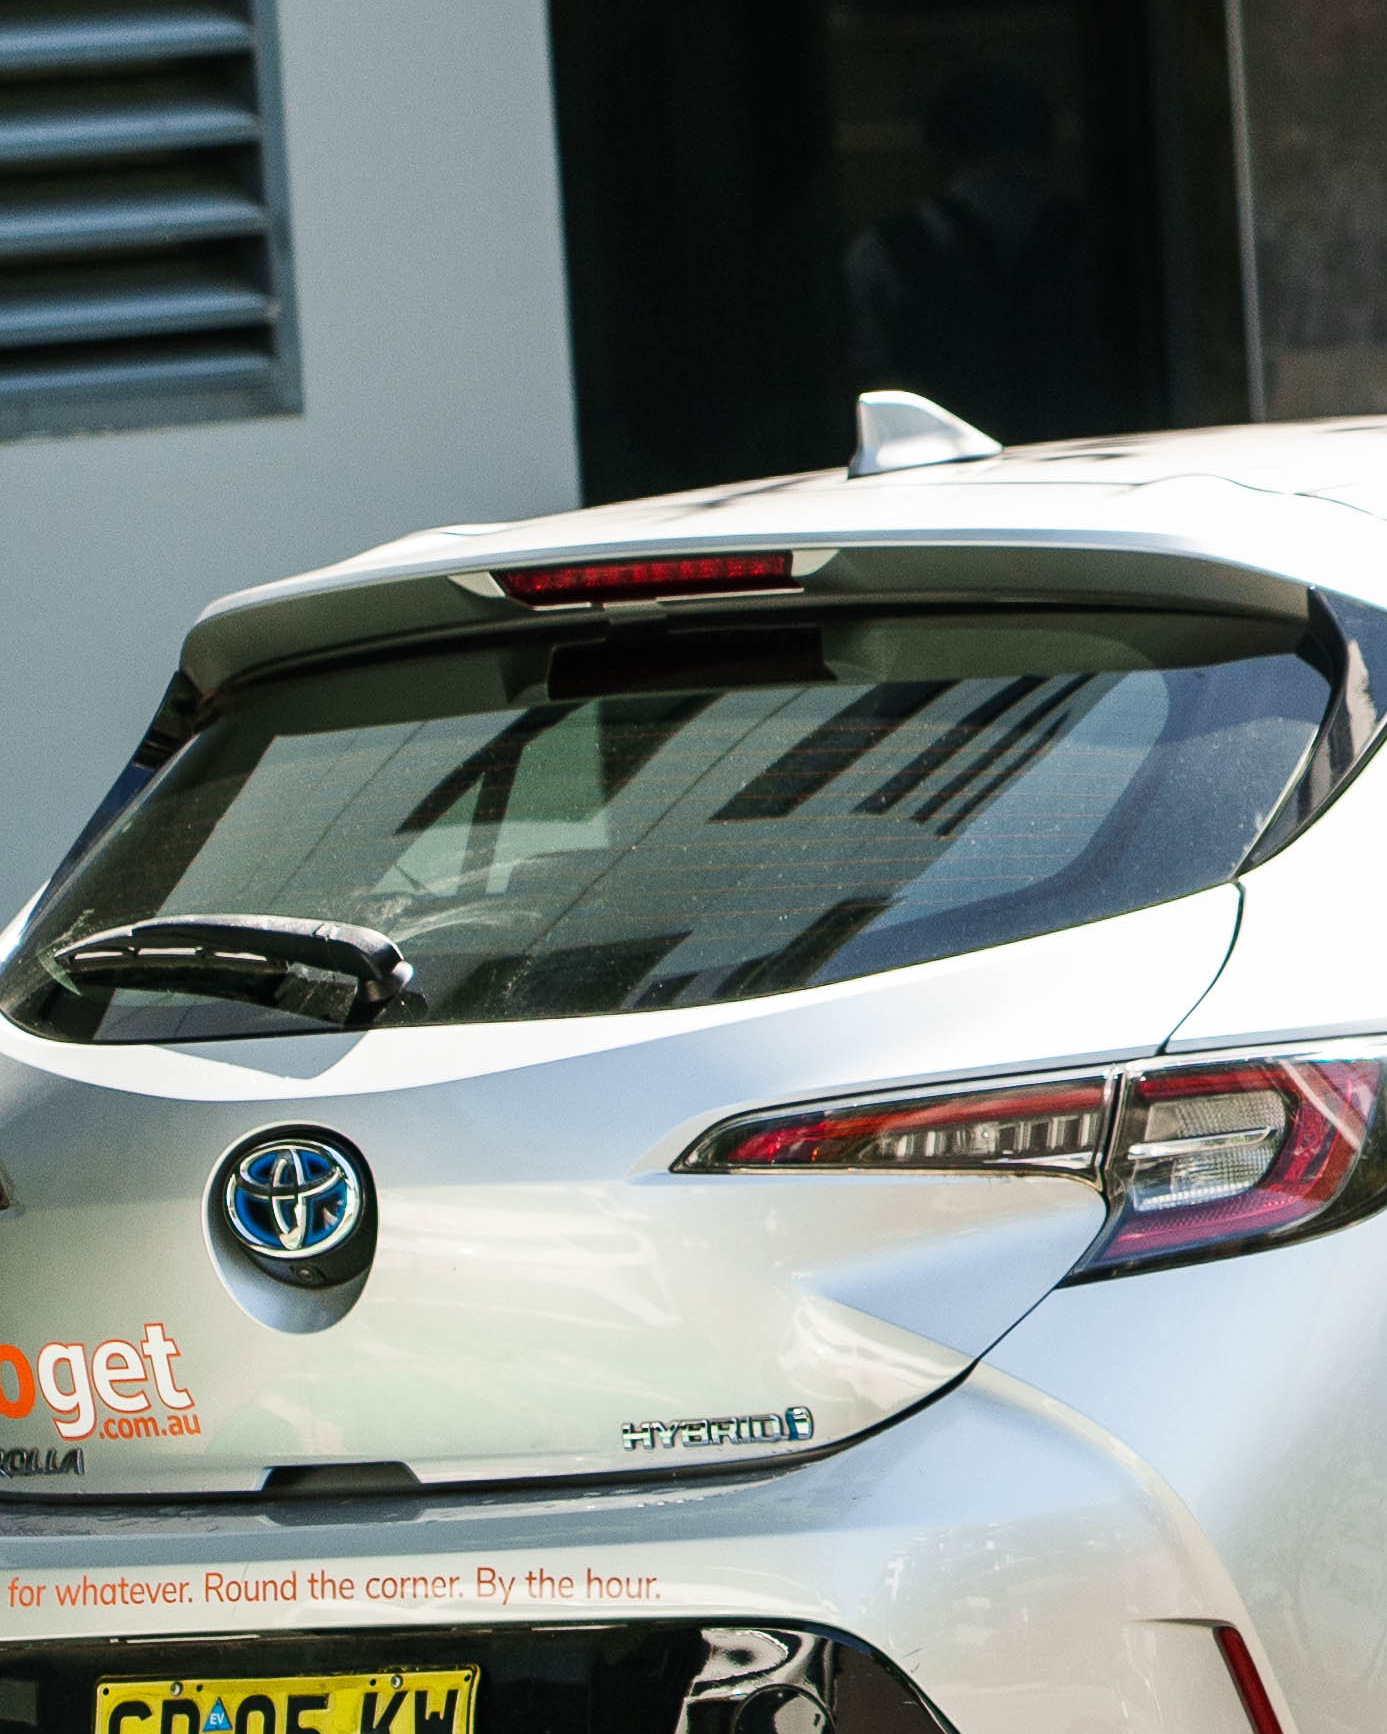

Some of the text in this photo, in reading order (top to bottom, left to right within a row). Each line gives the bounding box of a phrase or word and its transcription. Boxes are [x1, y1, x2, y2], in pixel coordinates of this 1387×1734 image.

[98, 1414, 201, 1441] .com.au
[621, 1413, 784, 1451] HYBRID
[8, 1567, 662, 1608] for whatever. Round the corner. By the hour.
[209, 1713, 225, 1726] EV
